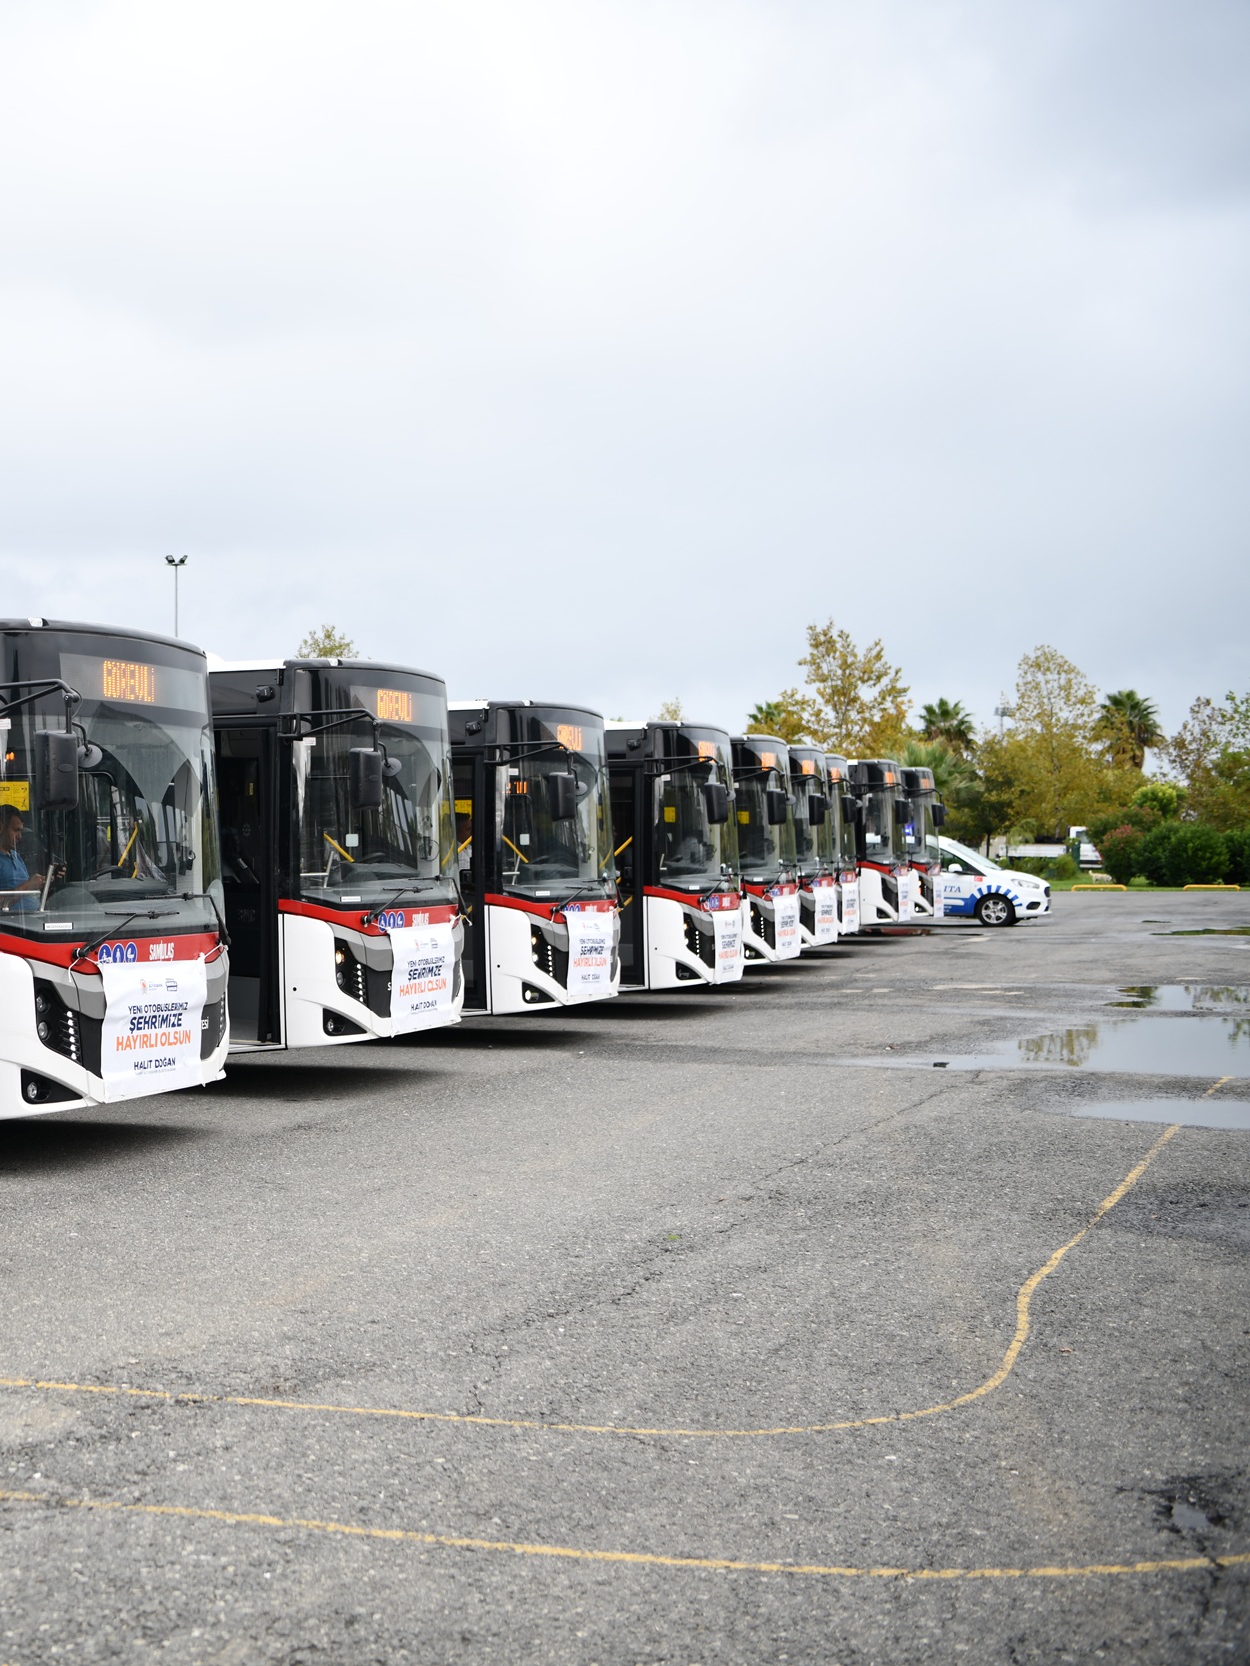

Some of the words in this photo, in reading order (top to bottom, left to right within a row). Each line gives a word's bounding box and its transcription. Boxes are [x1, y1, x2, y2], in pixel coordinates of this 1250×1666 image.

[103, 660, 154, 702] GÖREVLİ
[128, 1005, 142, 1015] YENİ
[129, 1012, 183, 1034] ŞEHRİMİZE
[116, 1033, 158, 1052] HAYIRLI
[160, 1030, 191, 1047] OLSUN
[133, 1059, 153, 1071] HALİT
